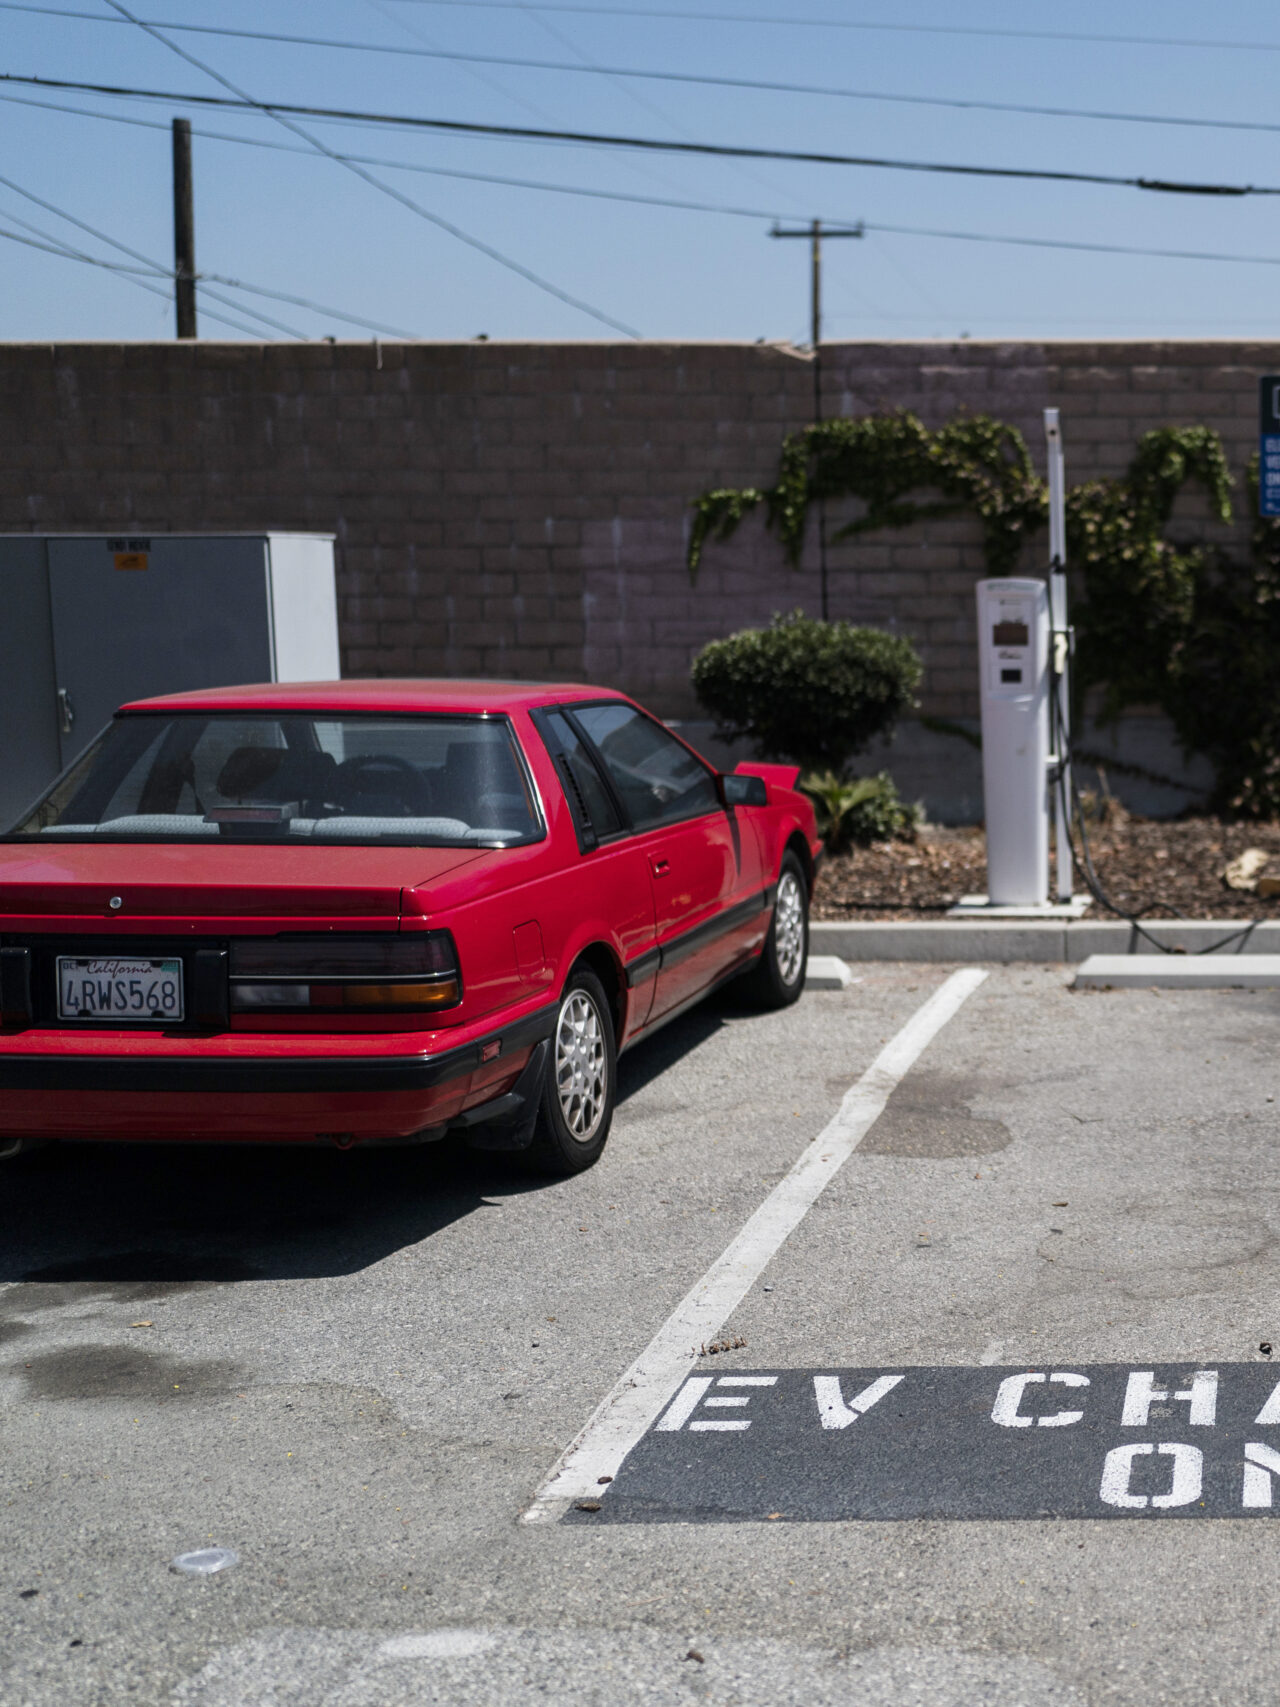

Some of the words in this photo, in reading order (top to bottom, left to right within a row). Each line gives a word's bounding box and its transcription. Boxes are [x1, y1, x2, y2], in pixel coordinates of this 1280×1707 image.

[87, 960, 153, 979] California
[66, 980, 176, 1011] 4RWS568
[653, 1375, 905, 1432] EV
